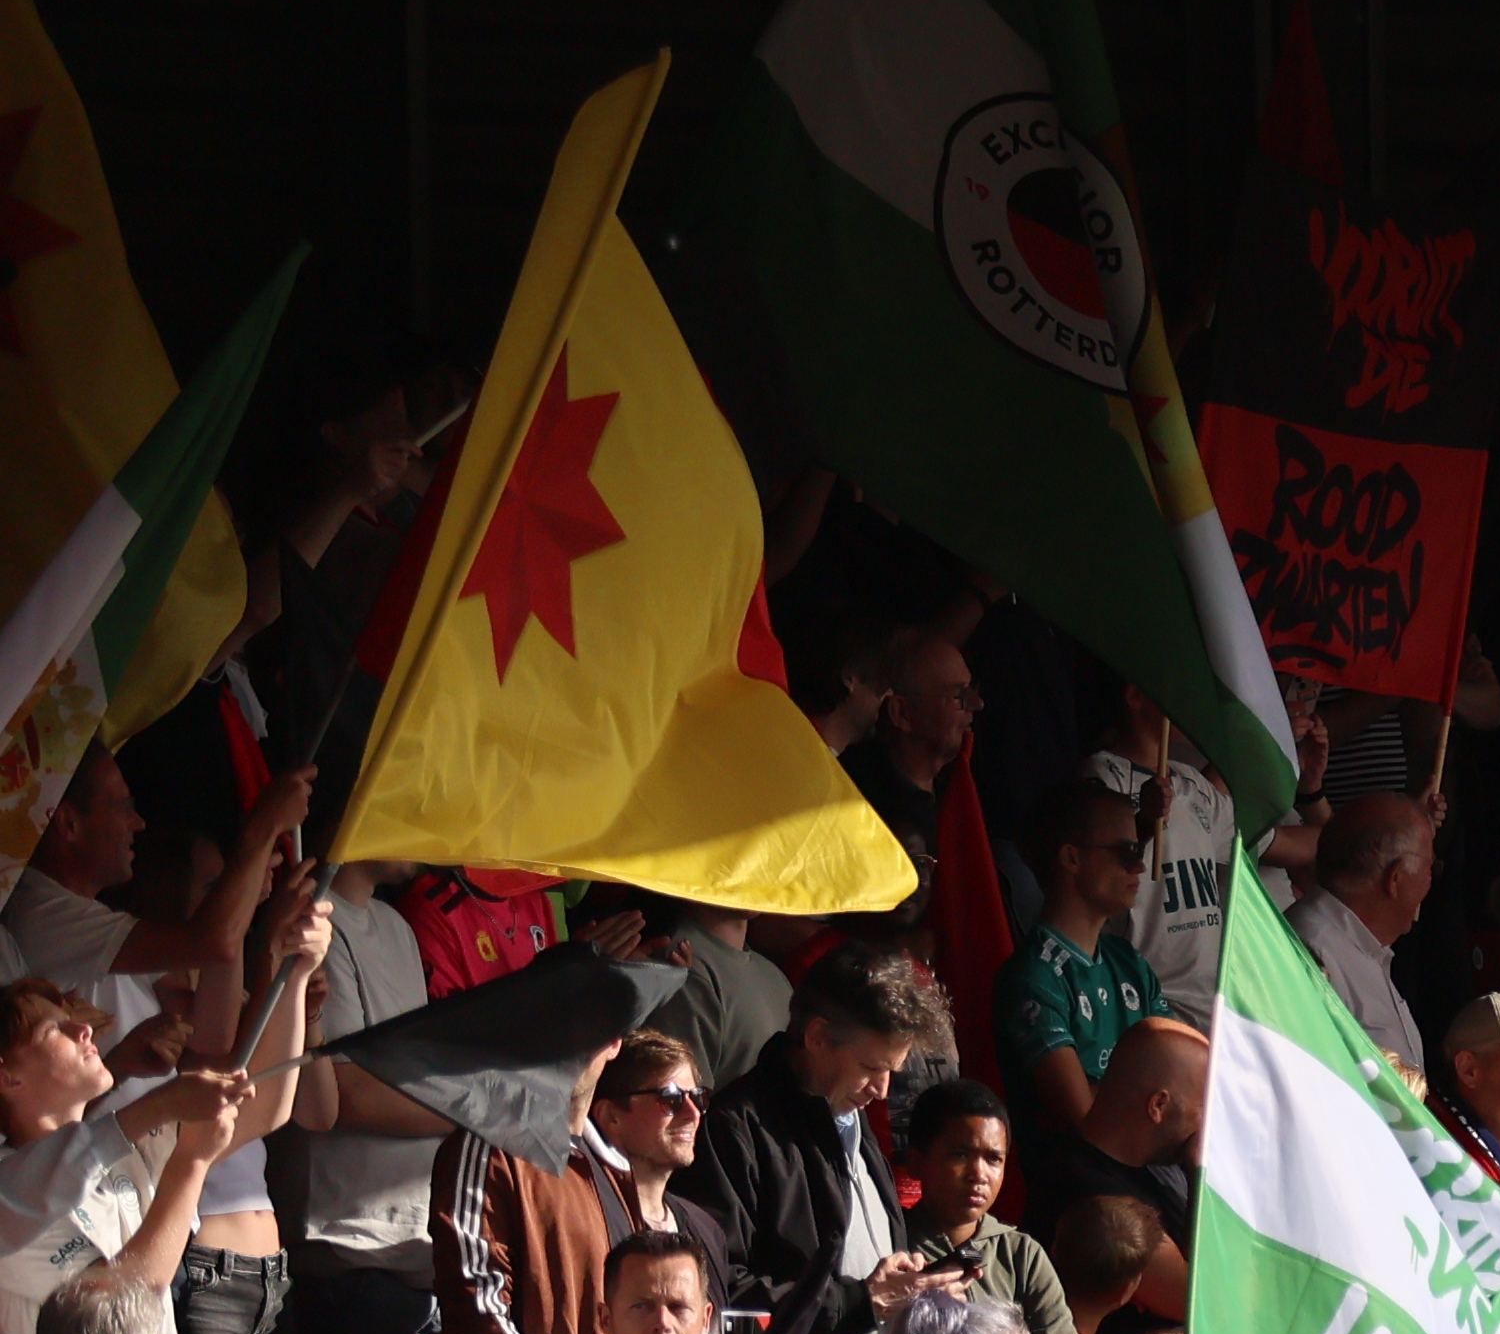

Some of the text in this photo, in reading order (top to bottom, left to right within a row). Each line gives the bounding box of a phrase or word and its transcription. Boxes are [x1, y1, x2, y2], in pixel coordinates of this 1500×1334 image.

[972, 239, 1120, 368] ROTTERD
[1345, 332, 1432, 415] DIE
[1267, 424, 1422, 562] ROOD
